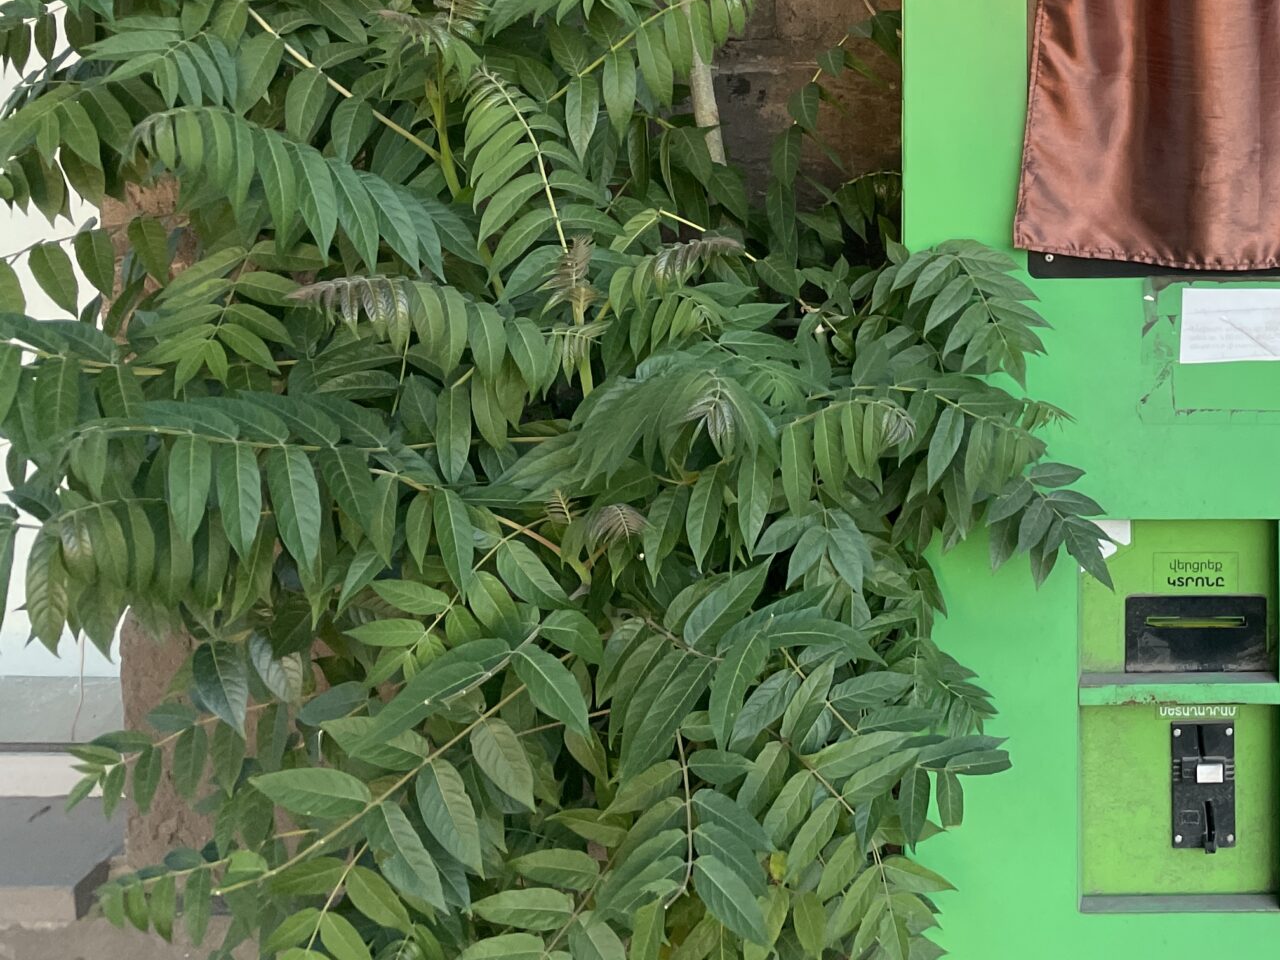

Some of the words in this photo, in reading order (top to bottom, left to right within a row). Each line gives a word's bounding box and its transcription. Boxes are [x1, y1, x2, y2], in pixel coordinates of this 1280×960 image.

[1169, 559, 1223, 573] վերցրեք
[1167, 576, 1225, 587] ԿՏՐՈՆԸ
[1159, 706, 1237, 717] ՄԵՏԱՂԱԴՐԱՄ
